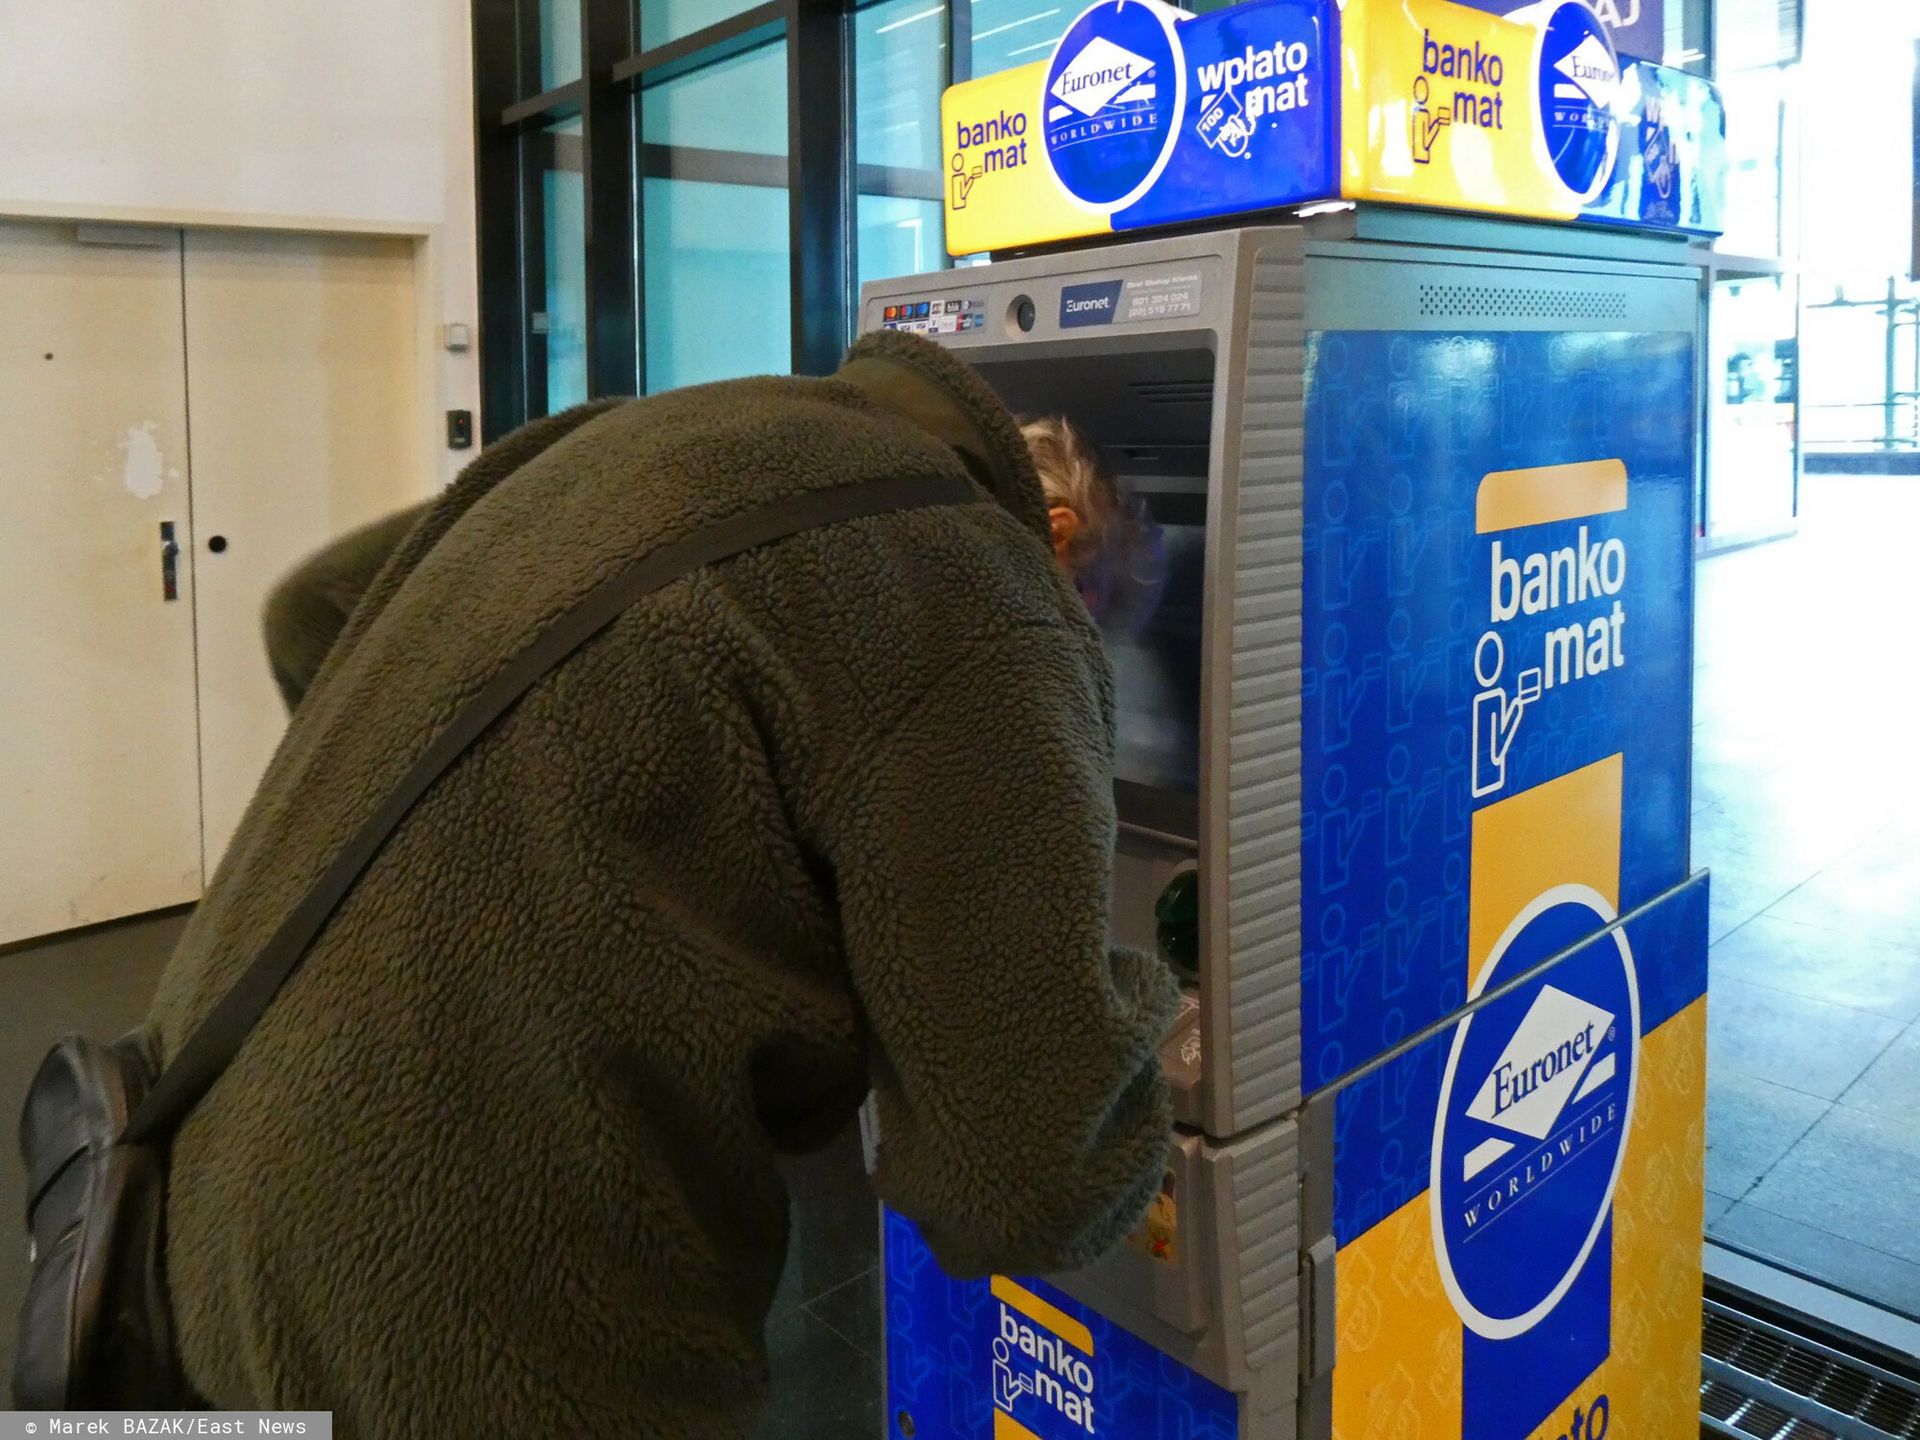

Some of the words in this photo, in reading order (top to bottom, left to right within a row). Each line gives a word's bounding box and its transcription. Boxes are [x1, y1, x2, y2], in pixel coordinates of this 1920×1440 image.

[1061, 61, 1133, 96] Euronet
[1197, 40, 1308, 93] wpłato
[1423, 28, 1503, 87] banko
[1244, 77, 1309, 118] mat
[1453, 89, 1503, 129] mat
[957, 110, 1027, 150] banko
[1051, 112, 1158, 146] WORLDWIDE
[984, 138, 1028, 174] mat
[1066, 297, 1109, 312] Euronet
[1490, 526, 1626, 622] banko
[1545, 600, 1625, 689] mat
[1491, 1020, 1594, 1119] Euronet
[1464, 1103, 1616, 1228] WORLDWIDE
[1000, 1302, 1093, 1394] banko
[1036, 1369, 1095, 1434] mat
